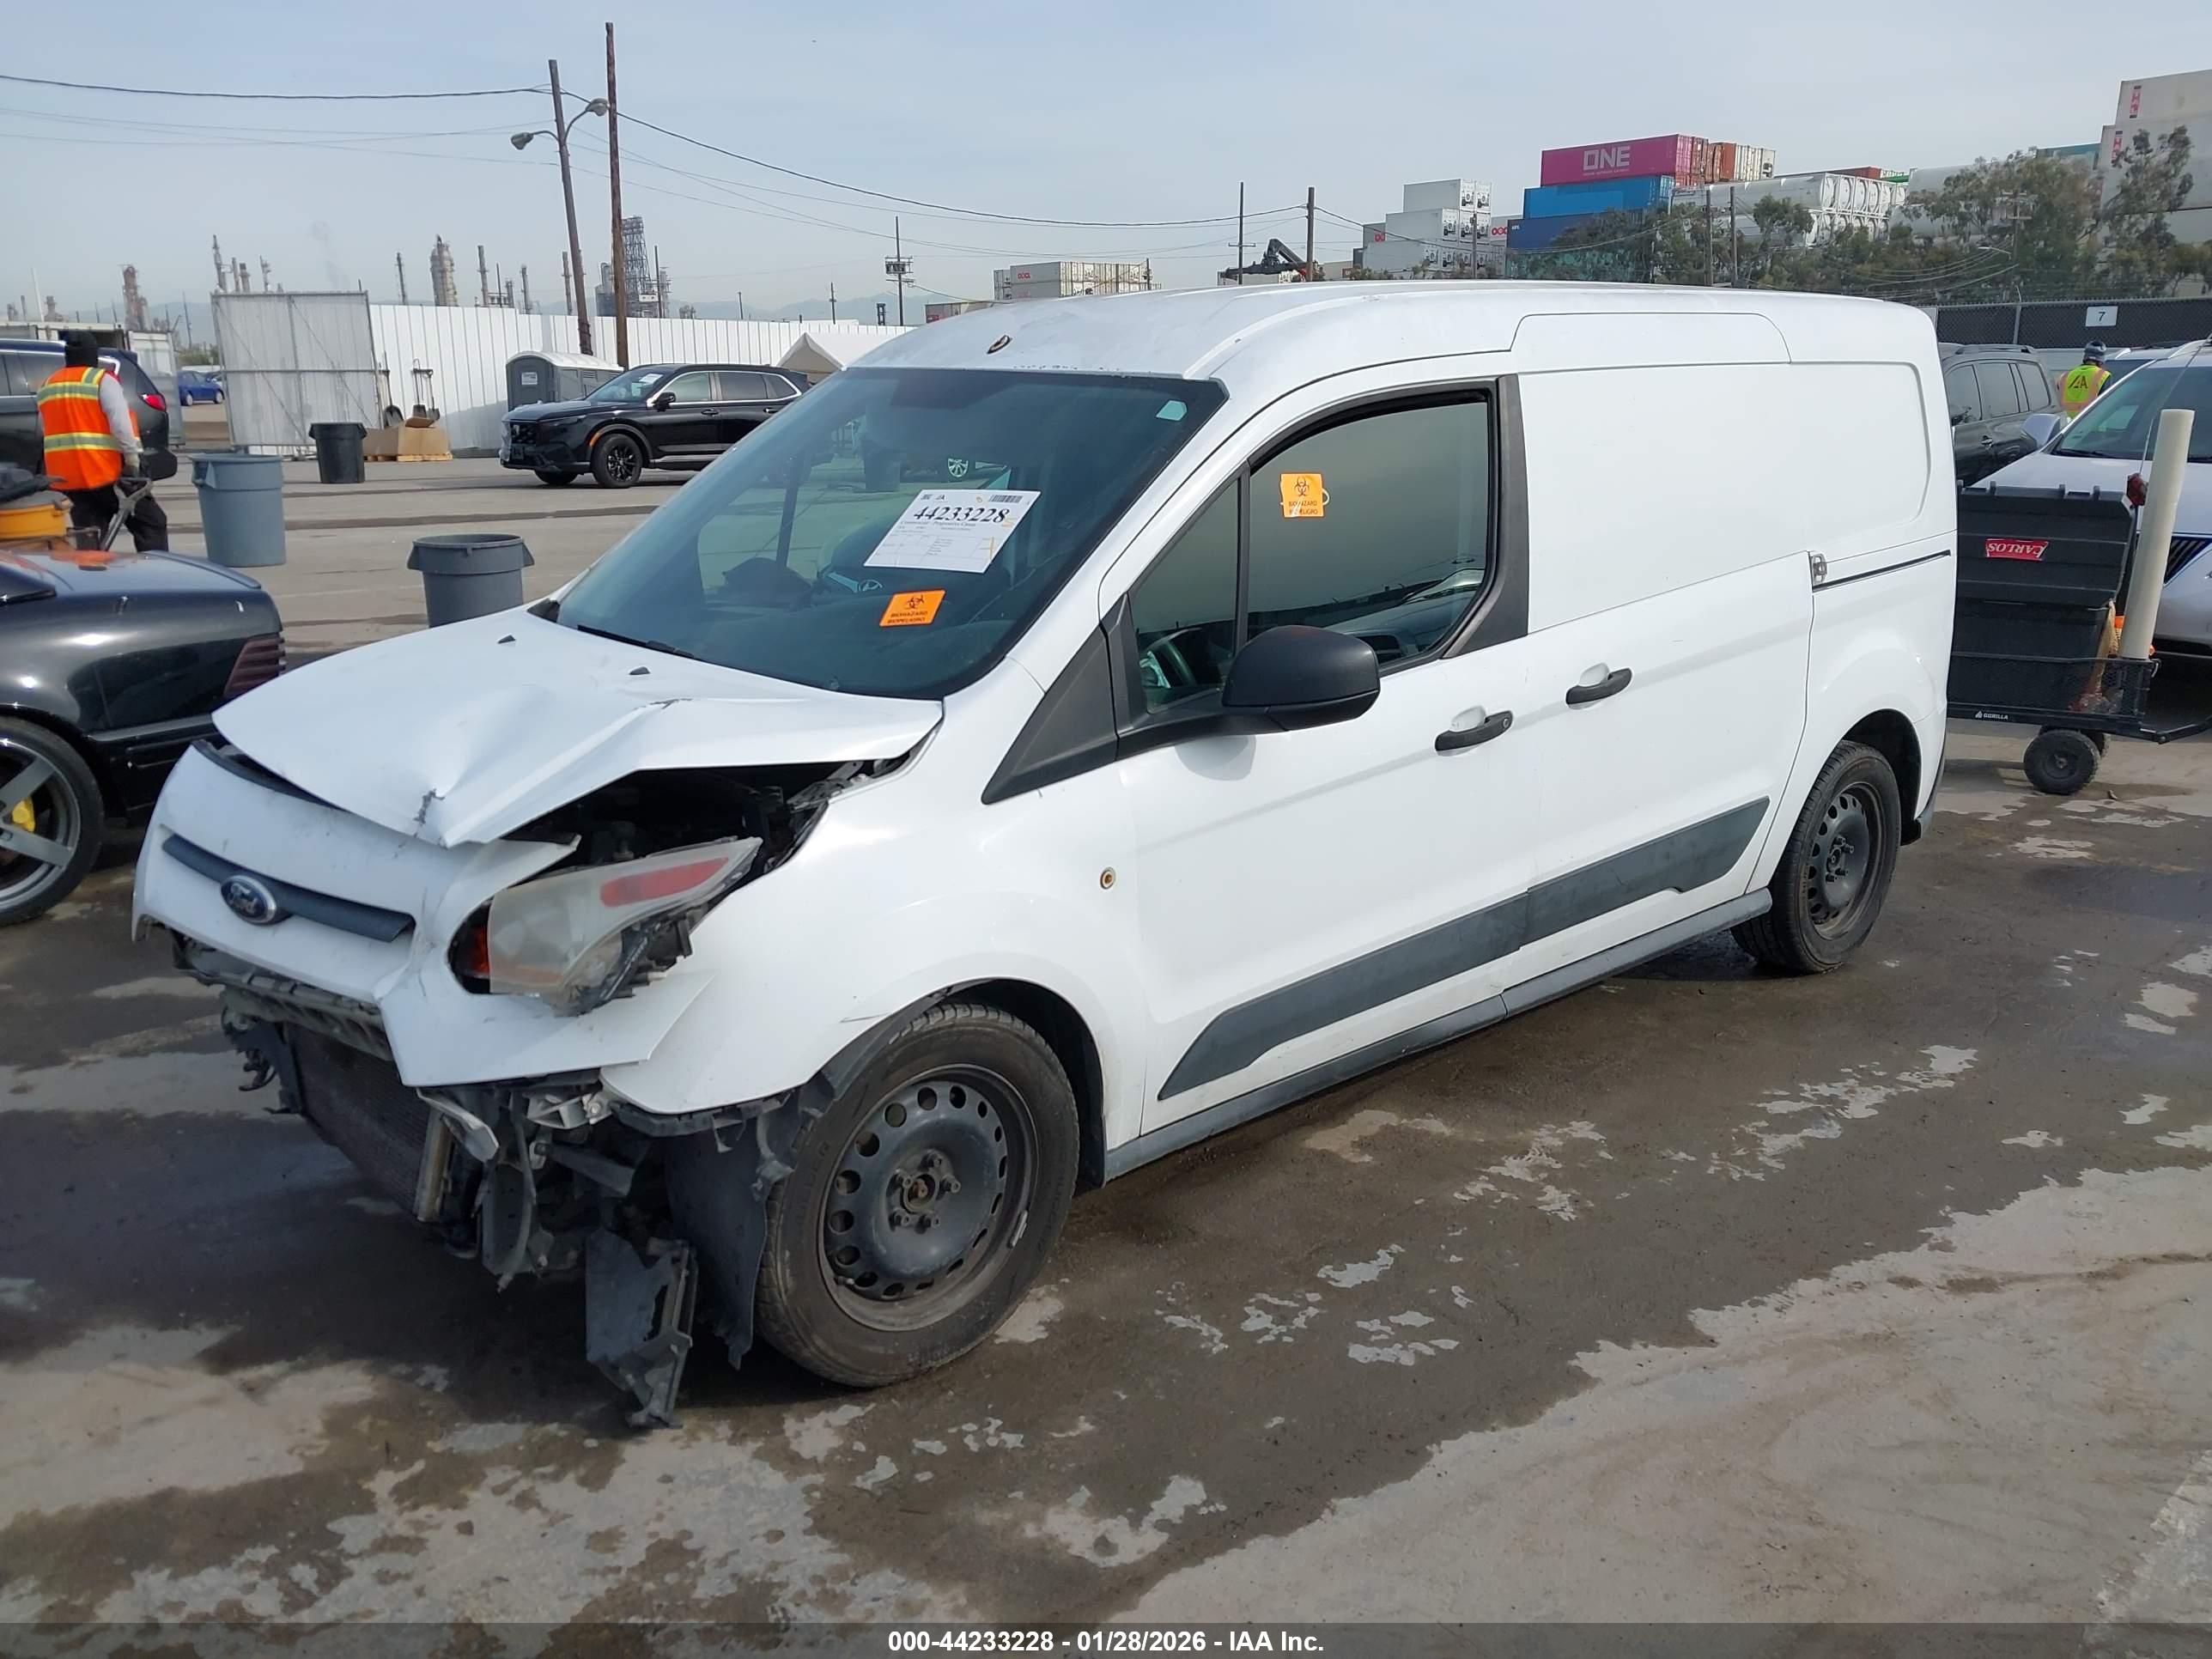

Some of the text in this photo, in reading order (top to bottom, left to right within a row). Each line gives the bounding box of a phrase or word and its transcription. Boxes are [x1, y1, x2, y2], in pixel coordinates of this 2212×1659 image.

[1583, 146, 1631, 171] ONE
[2098, 312, 2106, 321] 7
[914, 506, 1010, 523] 44233228
[1988, 543, 2045, 556] CARLOS
